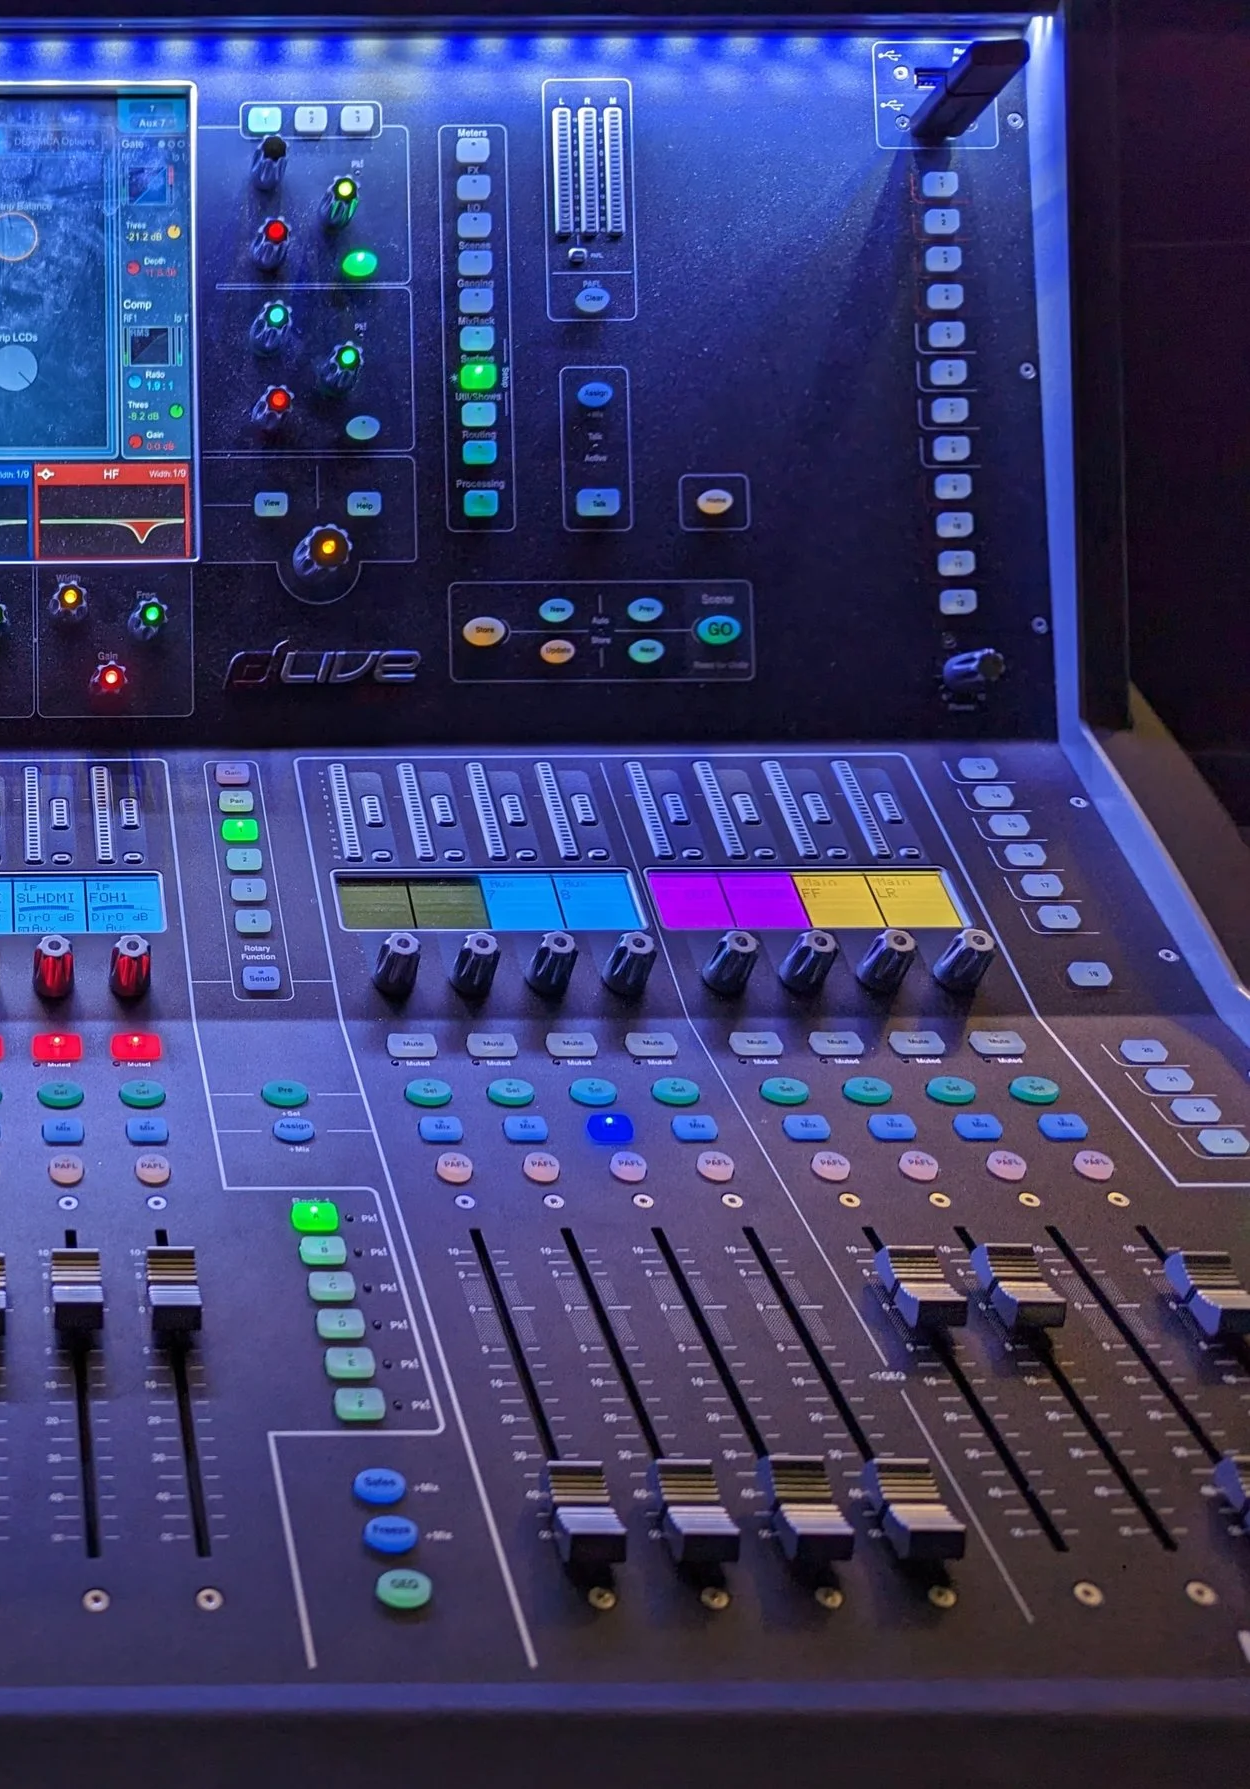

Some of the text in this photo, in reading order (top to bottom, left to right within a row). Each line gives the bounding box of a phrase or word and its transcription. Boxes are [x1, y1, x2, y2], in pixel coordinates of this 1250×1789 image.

[457, 128, 488, 138] Meters
[467, 166, 479, 174] FX
[467, 204, 481, 212] I/O
[124, 300, 152, 311] Comp
[458, 316, 495, 326] MixRack
[146, 430, 164, 439] Gain
[103, 469, 120, 480] HF
[456, 480, 506, 490] Processing
[356, 502, 373, 511] Help
[707, 622, 734, 637] GO
[16, 892, 75, 904] SLHDMI
[89, 892, 128, 902] FOH1
[876, 888, 900, 898] LR
[244, 944, 271, 954] Rotary
[241, 952, 276, 961] Function
[279, 1122, 310, 1131] Assign
